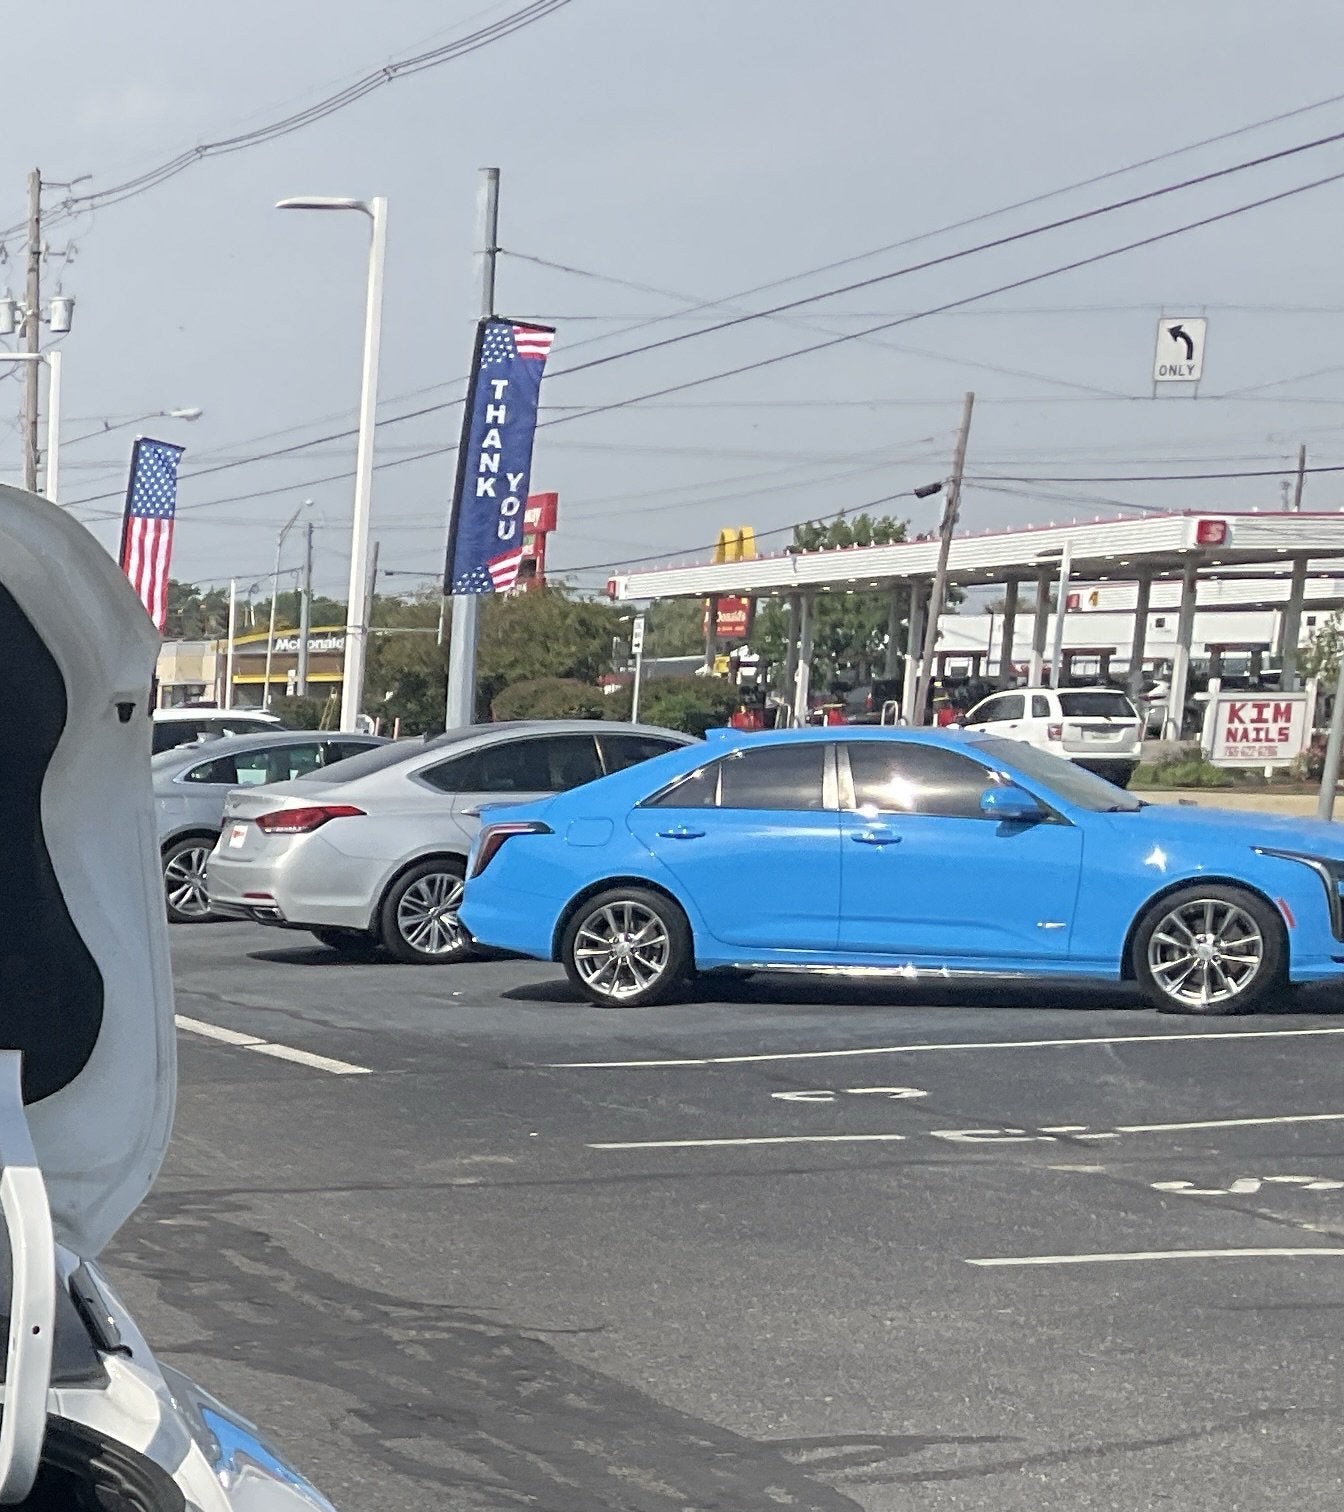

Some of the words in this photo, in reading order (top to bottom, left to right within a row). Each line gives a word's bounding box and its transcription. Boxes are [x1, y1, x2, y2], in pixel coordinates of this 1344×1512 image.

[1159, 364, 1195, 377] ONLY
[475, 379, 509, 497] THANK
[498, 472, 524, 540] YOU
[1228, 703, 1292, 724] KIM
[1226, 727, 1290, 742] NAILS
